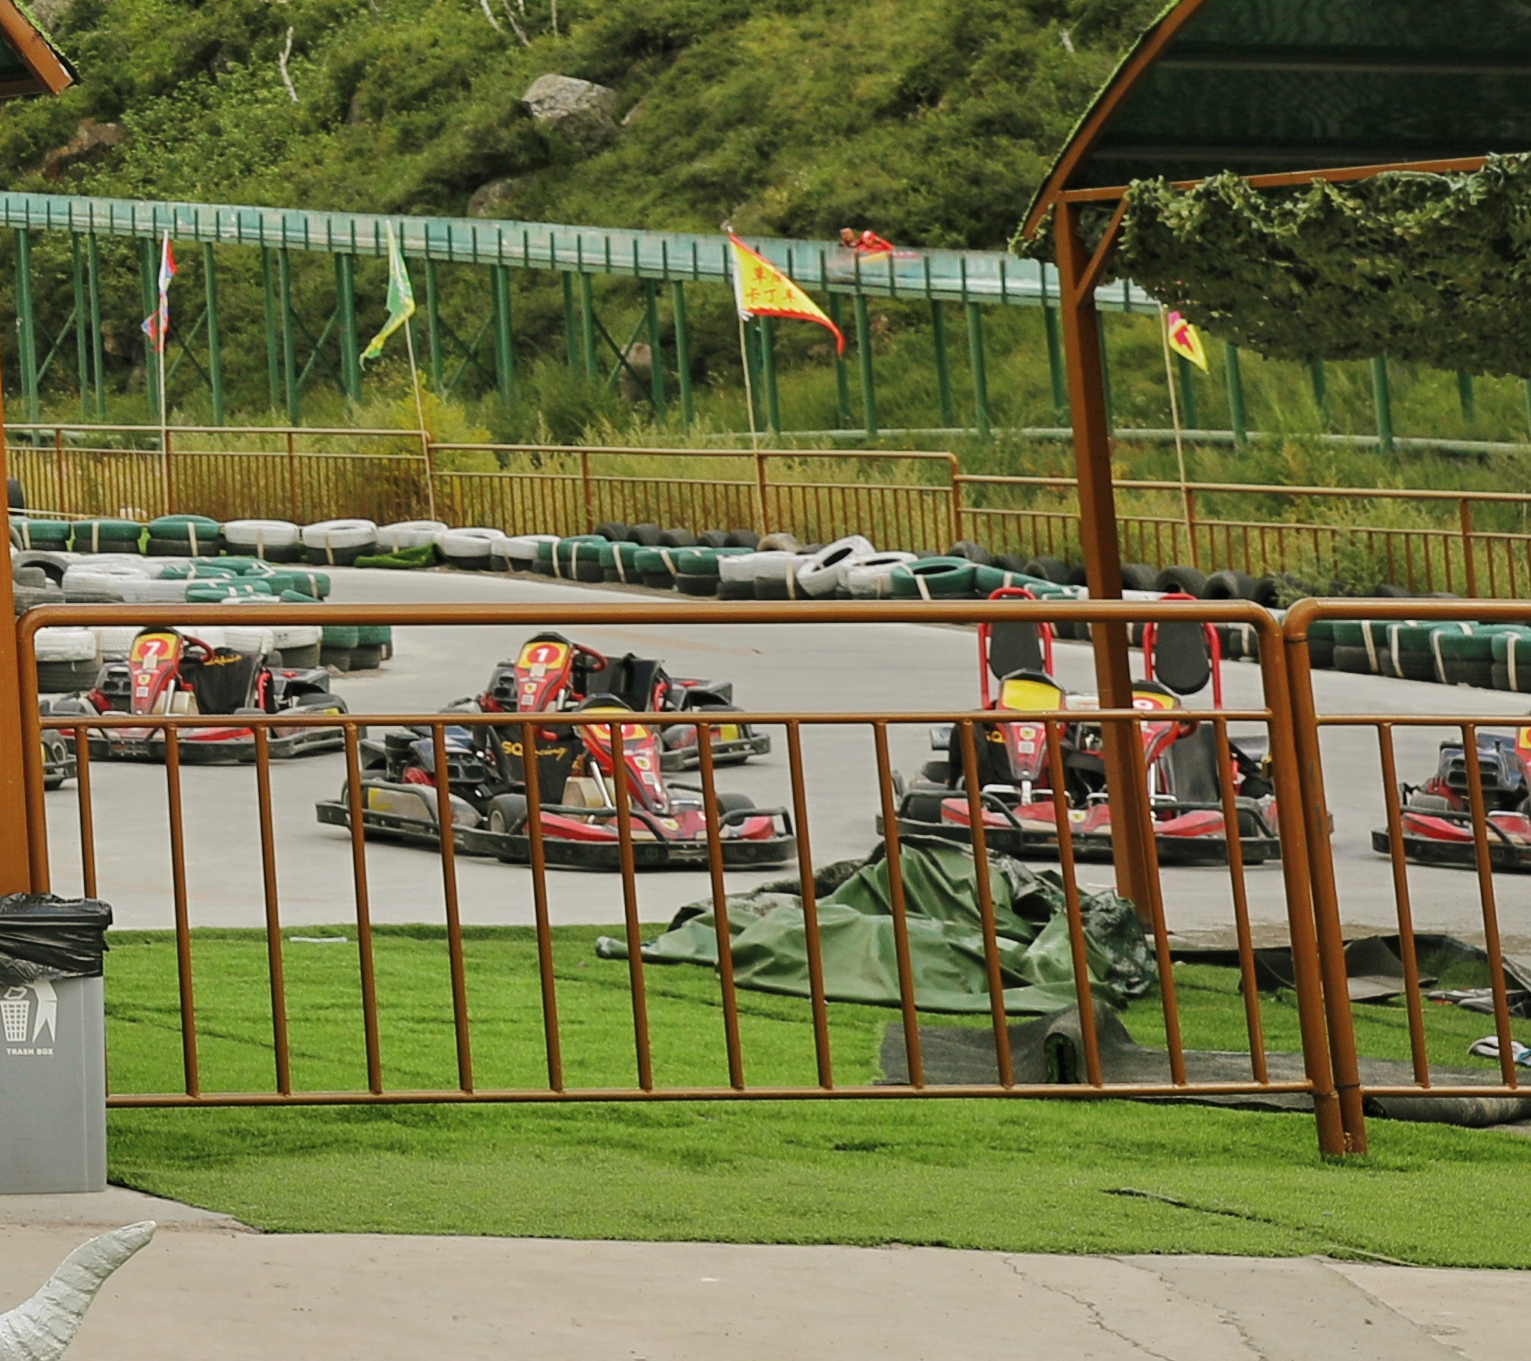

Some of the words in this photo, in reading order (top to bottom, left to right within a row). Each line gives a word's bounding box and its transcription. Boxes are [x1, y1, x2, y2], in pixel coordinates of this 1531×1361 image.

[536, 647, 550, 662] 1
[6, 1048, 35, 1056] TRASH
[36, 1048, 54, 1056] BOX
